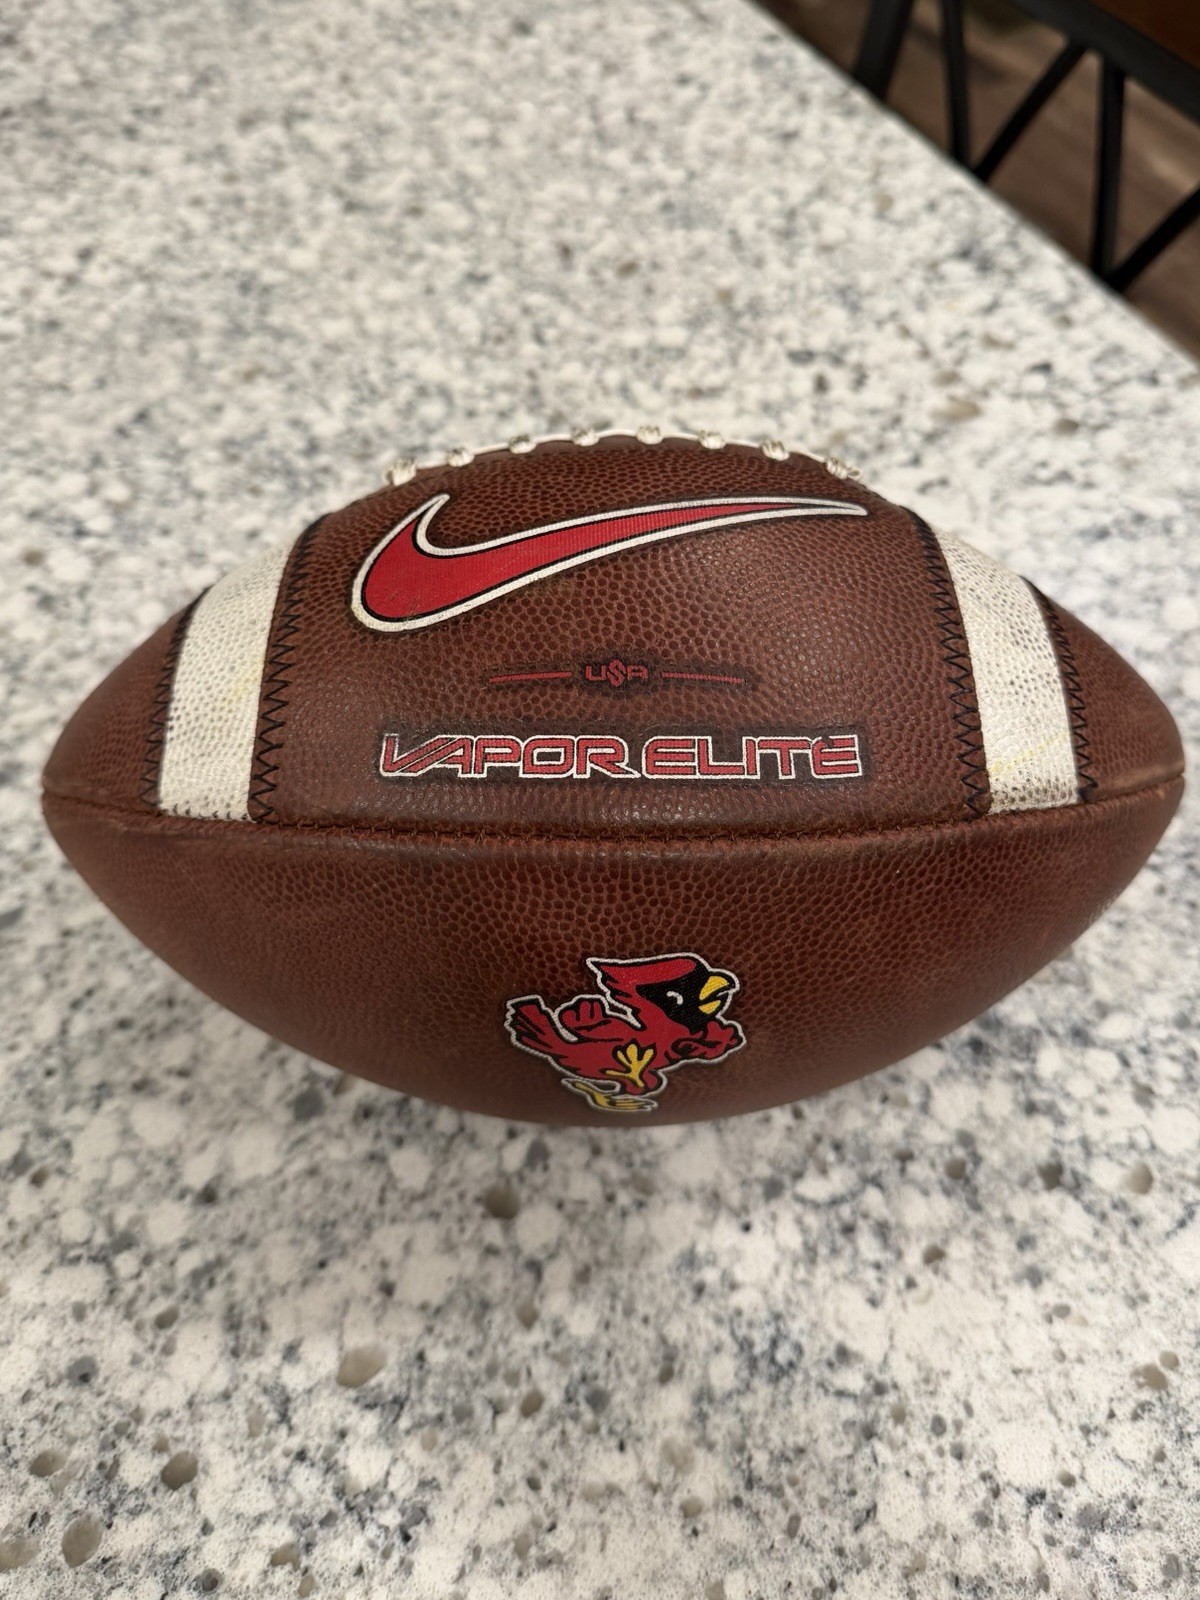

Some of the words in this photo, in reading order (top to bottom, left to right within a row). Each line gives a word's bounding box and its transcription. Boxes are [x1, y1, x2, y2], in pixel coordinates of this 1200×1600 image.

[585, 659, 648, 686] USA
[380, 733, 641, 778] VAPOR
[641, 734, 863, 779] ELITE
